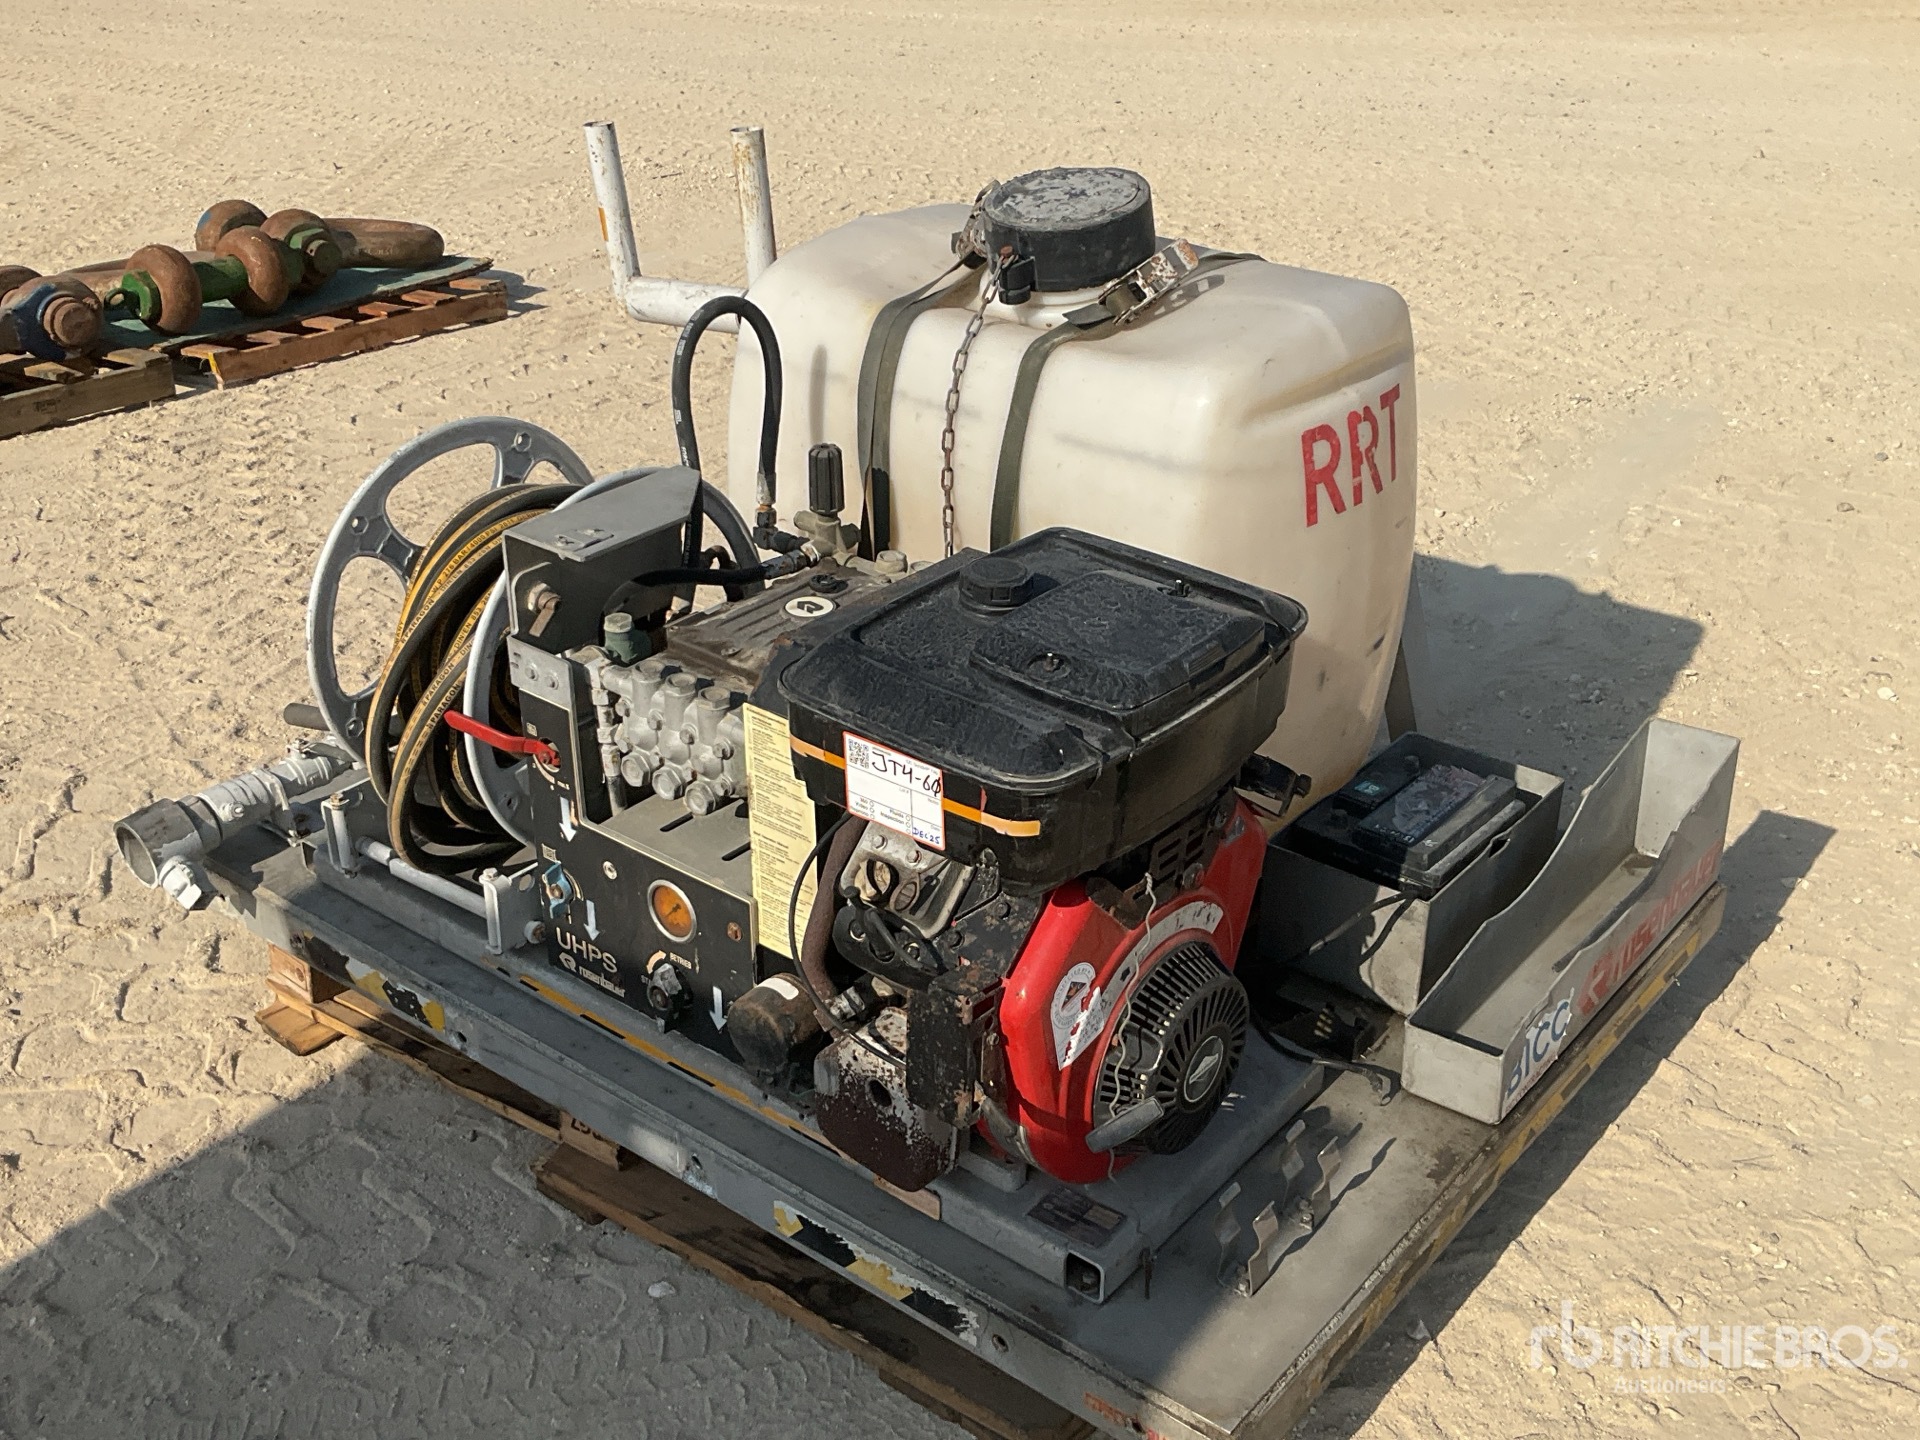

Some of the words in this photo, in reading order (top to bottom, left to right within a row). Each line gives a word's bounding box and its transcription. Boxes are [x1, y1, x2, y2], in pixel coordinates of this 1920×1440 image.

[1301, 382, 1401, 528] RRT
[454, 549, 468, 565] BAR
[405, 598, 435, 638] PARAGON
[425, 662, 455, 705] PARAGON
[430, 683, 461, 724] PARAGON
[555, 926, 618, 973] UHPS
